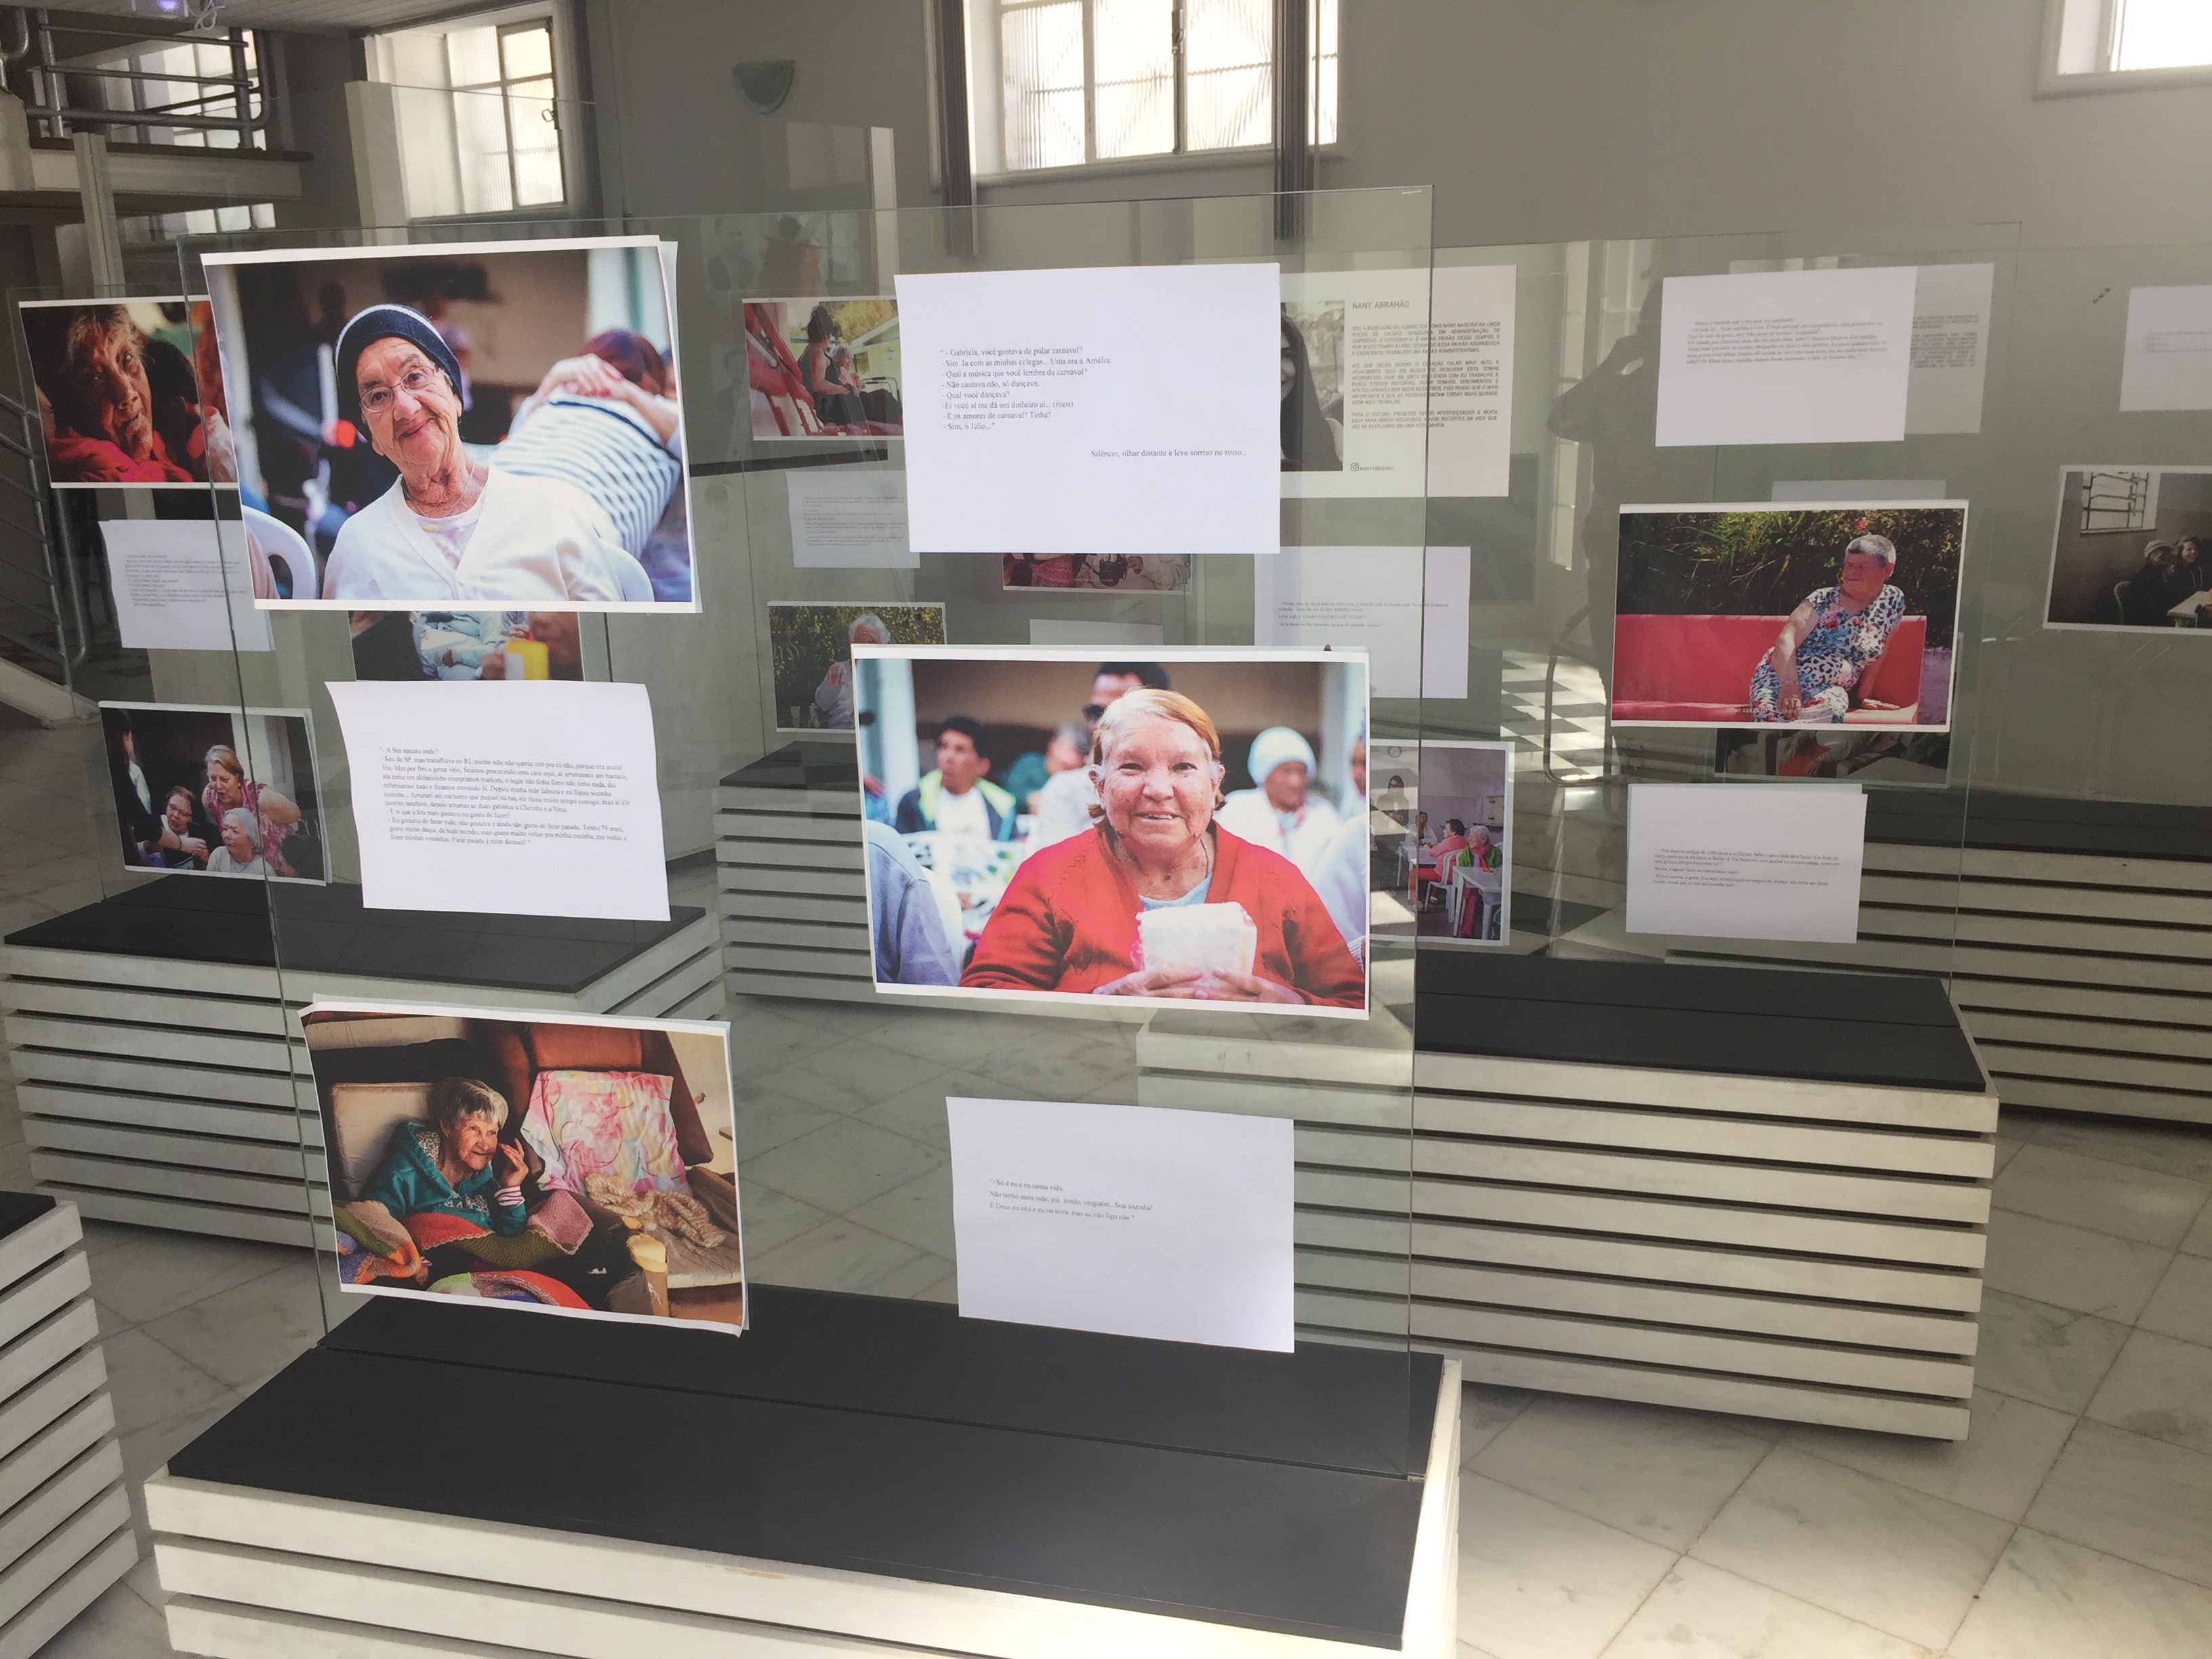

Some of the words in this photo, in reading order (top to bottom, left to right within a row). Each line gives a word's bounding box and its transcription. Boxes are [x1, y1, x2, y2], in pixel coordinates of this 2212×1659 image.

[1374, 300, 1409, 308] ABRAHÃO
[998, 348, 1023, 357] gostava
[1033, 348, 1050, 356] pular
[946, 370, 961, 379] Qual
[987, 380, 1000, 388] não,
[946, 392, 962, 400] Qual
[980, 391, 1010, 399] dançava?
[1052, 401, 1073, 409] (risos)
[948, 423, 962, 431] Sim,
[1106, 1212, 1118, 1221] ligo
